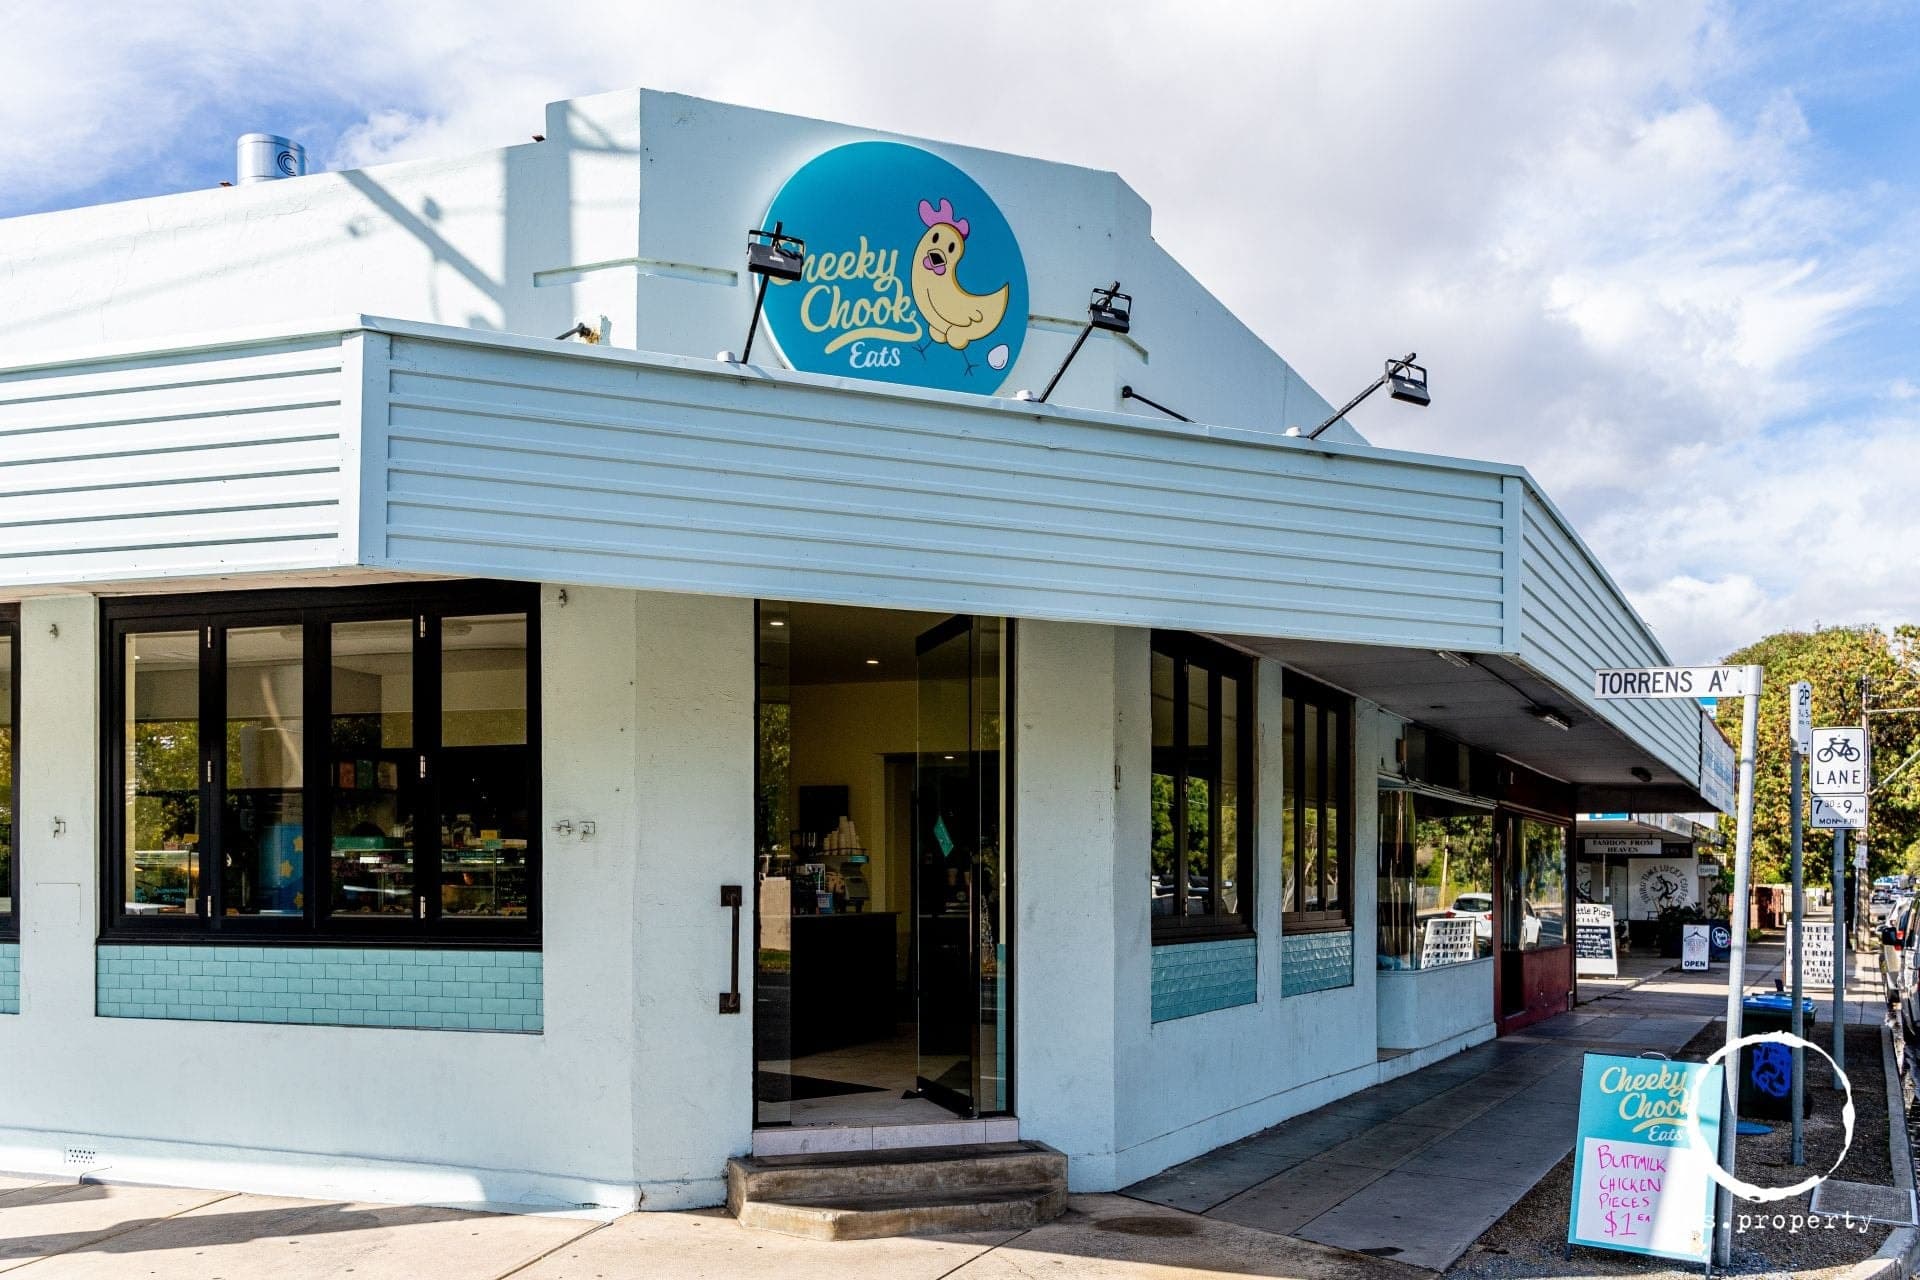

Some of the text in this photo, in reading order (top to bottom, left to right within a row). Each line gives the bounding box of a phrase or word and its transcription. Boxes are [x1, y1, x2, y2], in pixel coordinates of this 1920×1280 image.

[800, 278, 917, 333] Chook
[849, 341, 901, 369] Eats
[1598, 670, 1693, 695] TORRENS
[1799, 689, 1810, 706] 2P
[1816, 769, 1862, 785] LANE
[1576, 906, 1611, 918] ttle Pigs
[1599, 1063, 1689, 1098] Cheeky
[1647, 1124, 1684, 1142] Eats
[1599, 1175, 1661, 1193] CHICKEN
[1599, 1193, 1650, 1210] PIECES
